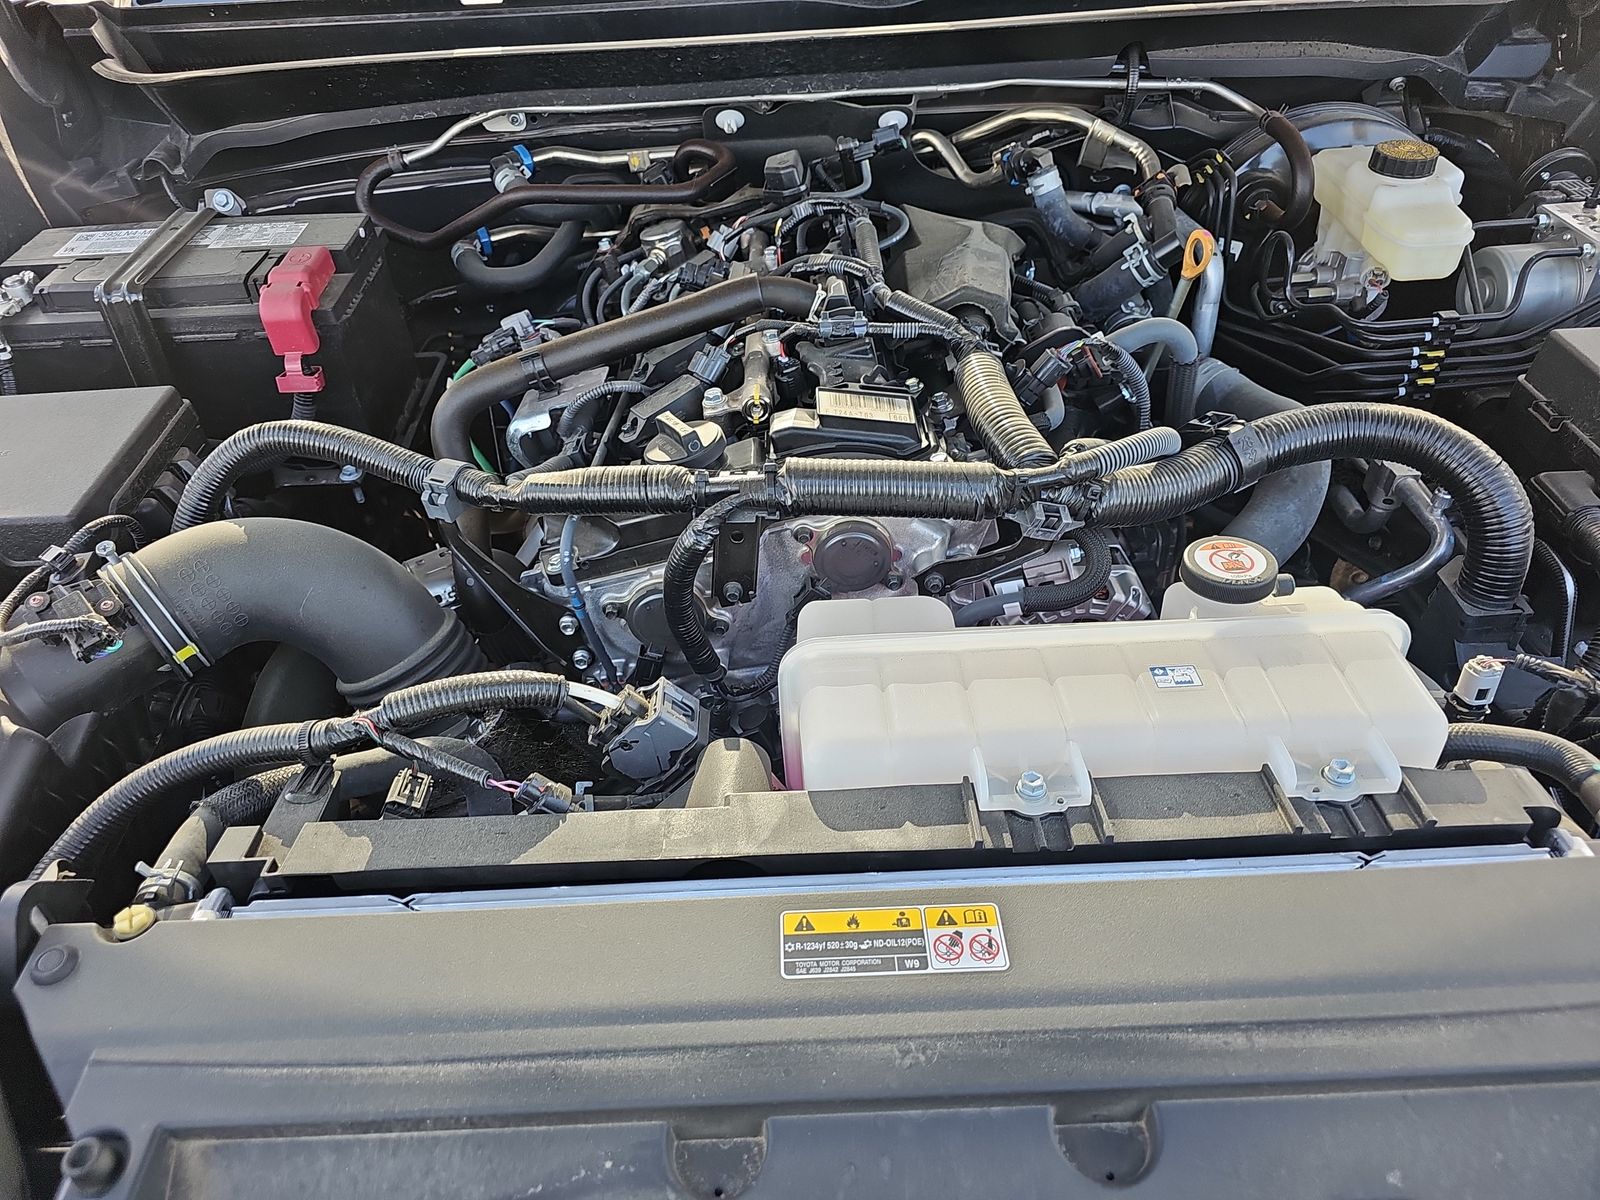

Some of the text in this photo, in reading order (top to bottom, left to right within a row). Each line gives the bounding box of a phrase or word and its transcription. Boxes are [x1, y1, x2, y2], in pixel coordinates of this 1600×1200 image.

[795, 937, 925, 952] R-1234yf 520±30g ND-OIL12(POE)
[841, 958, 882, 967] CORPORATION
[904, 959, 921, 969] W9
